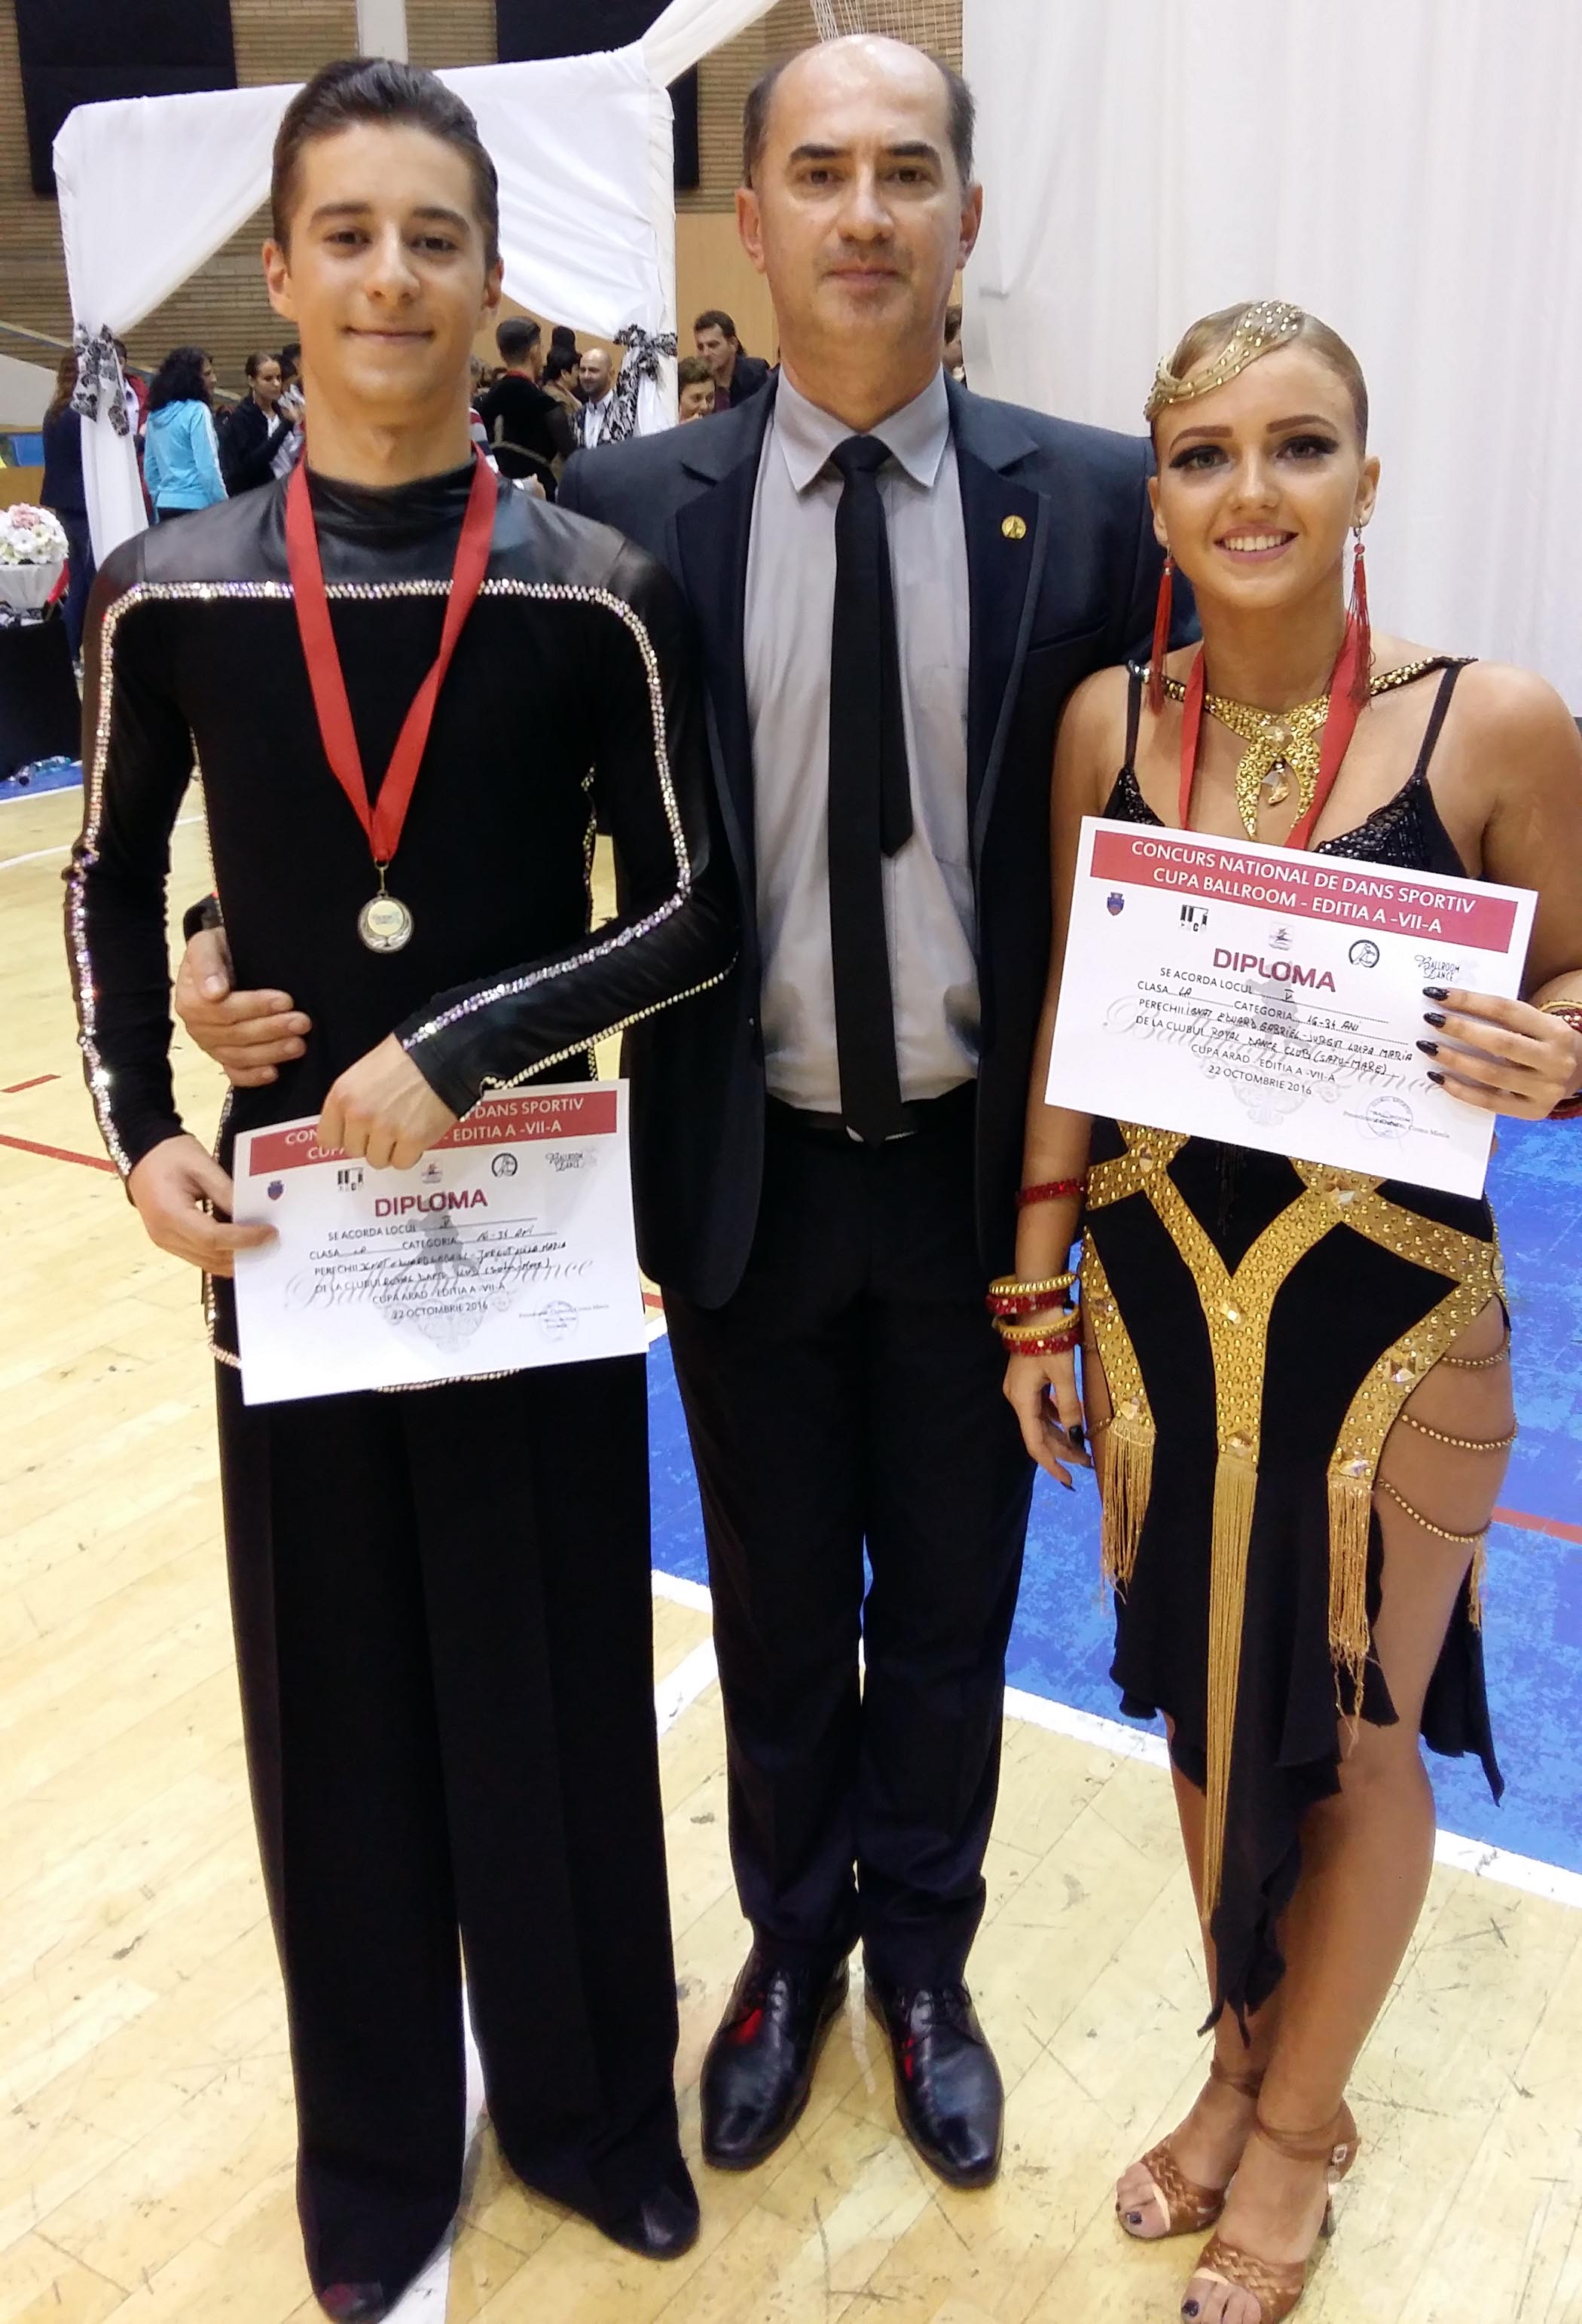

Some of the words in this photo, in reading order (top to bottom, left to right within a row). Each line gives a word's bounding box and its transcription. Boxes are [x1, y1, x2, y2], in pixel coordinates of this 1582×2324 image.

[1132, 841, 1216, 867] CONCURS
[1220, 856, 1309, 885] NATIONAL
[1314, 872, 1337, 890] DE
[1342, 878, 1394, 899] DANS
[1398, 887, 1476, 913] SPORTIV
[1153, 868, 1199, 889] CUPA
[1203, 876, 1296, 907] BALLROOM
[1312, 897, 1369, 921] EDITIA
[1373, 909, 1386, 924] A
[1160, 967, 1171, 978] SE
[1174, 970, 1217, 986] ACORDA
[1220, 980, 1253, 994] LOCUL
[1213, 948, 1336, 992] DIPLOMA
[1138, 981, 1168, 994] CLASA
[1234, 1000, 1293, 1021] CATEGORIA
[1136, 1015, 1149, 1026] DE
[1153, 1018, 1163, 1028] LA
[1167, 1022, 1205, 1037] CLUBUL
[1211, 1027, 1240, 1041] ROYAL
[1248, 1037, 1278, 1052] DANCE
[1191, 1044, 1219, 1057] CUPA
[1221, 1050, 1251, 1064] ARAD
[1260, 1059, 1293, 1073] EDITIA
[1208, 1064, 1220, 1076] 22
[1223, 1068, 1284, 1089] OCTOMBRIE
[1287, 1081, 1312, 1095] 2016
[475, 1105, 518, 1119] DANS
[521, 1098, 584, 1115] SPORTIV
[454, 1126, 502, 1142] EDITIA
[505, 1125, 516, 1137] A
[375, 1189, 488, 1217] DIPLOMA
